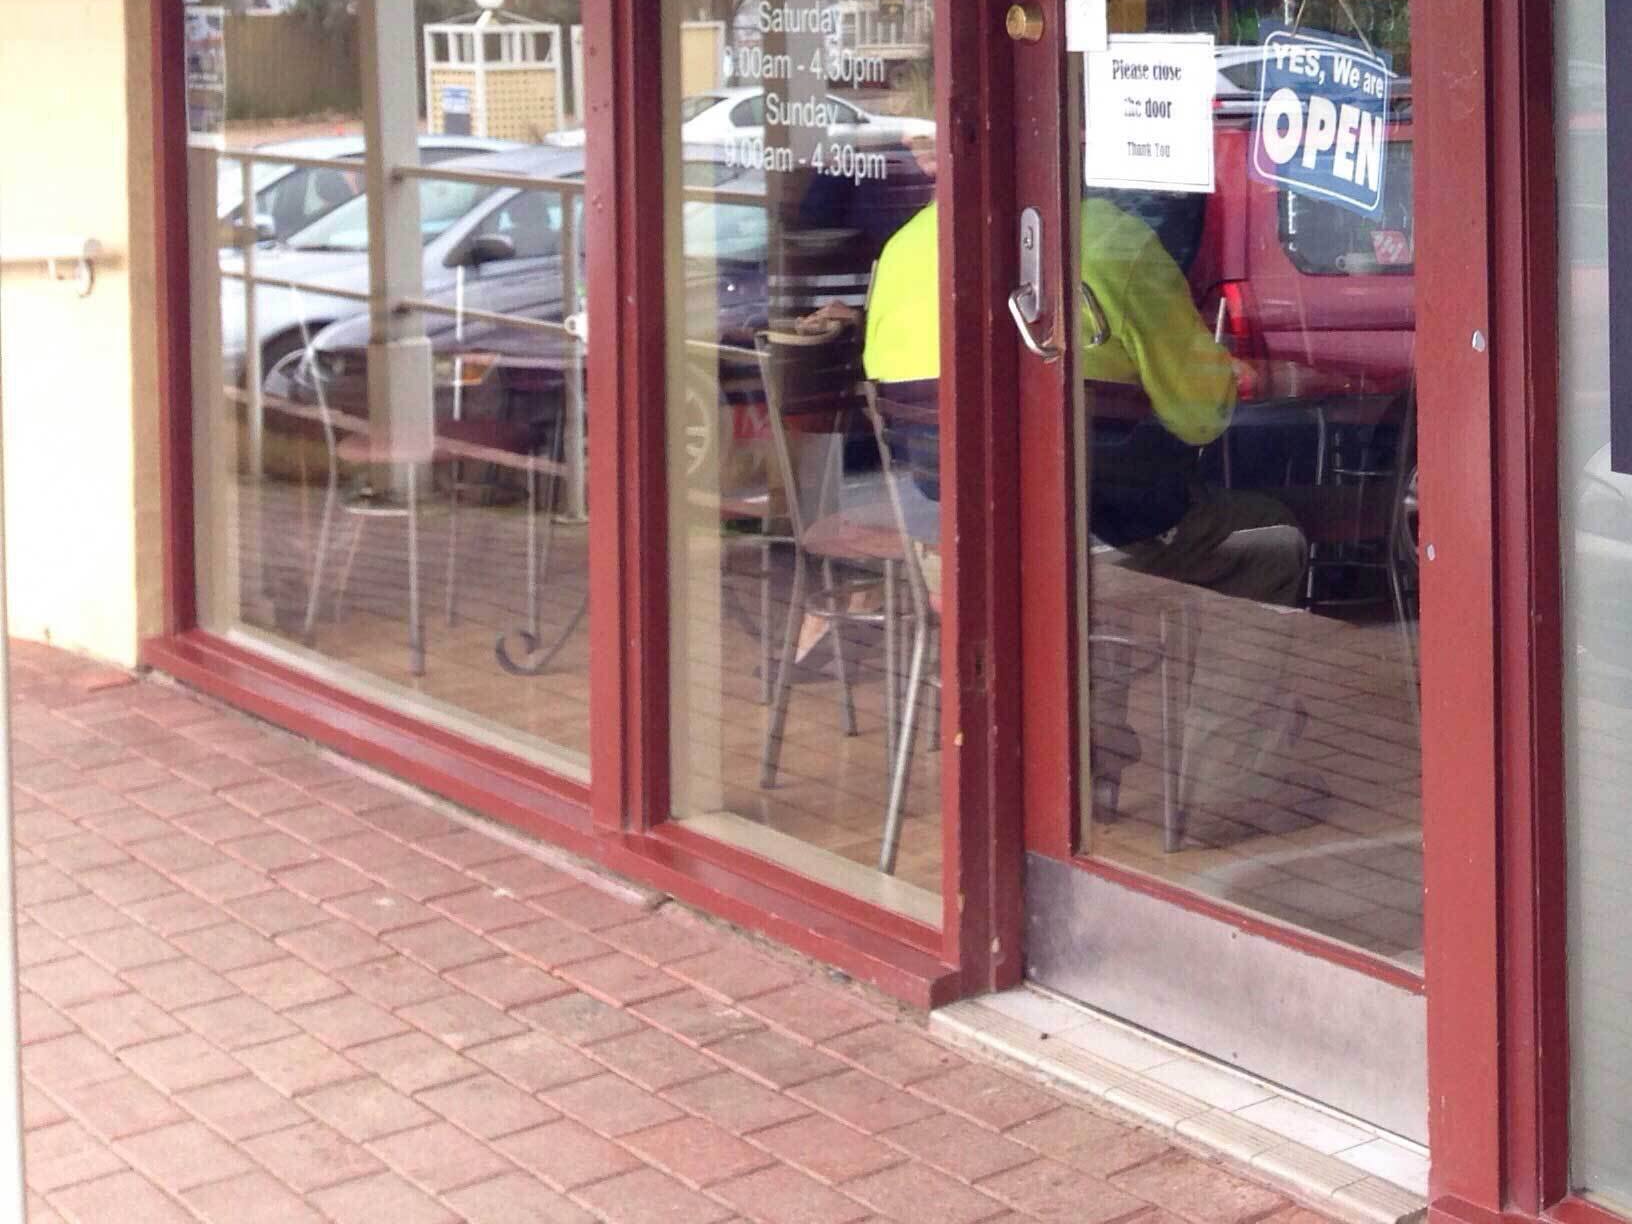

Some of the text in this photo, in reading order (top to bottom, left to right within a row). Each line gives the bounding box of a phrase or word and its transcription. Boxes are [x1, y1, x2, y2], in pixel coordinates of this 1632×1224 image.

[758, 0, 841, 41] Saturday
[809, 48, 884, 89] 4.30pm
[1273, 43, 1384, 98] YES, We are
[766, 93, 839, 133] Sunday
[1145, 98, 1172, 119] door
[1262, 88, 1383, 193] OPEN
[811, 142, 887, 186] 4.30pm
